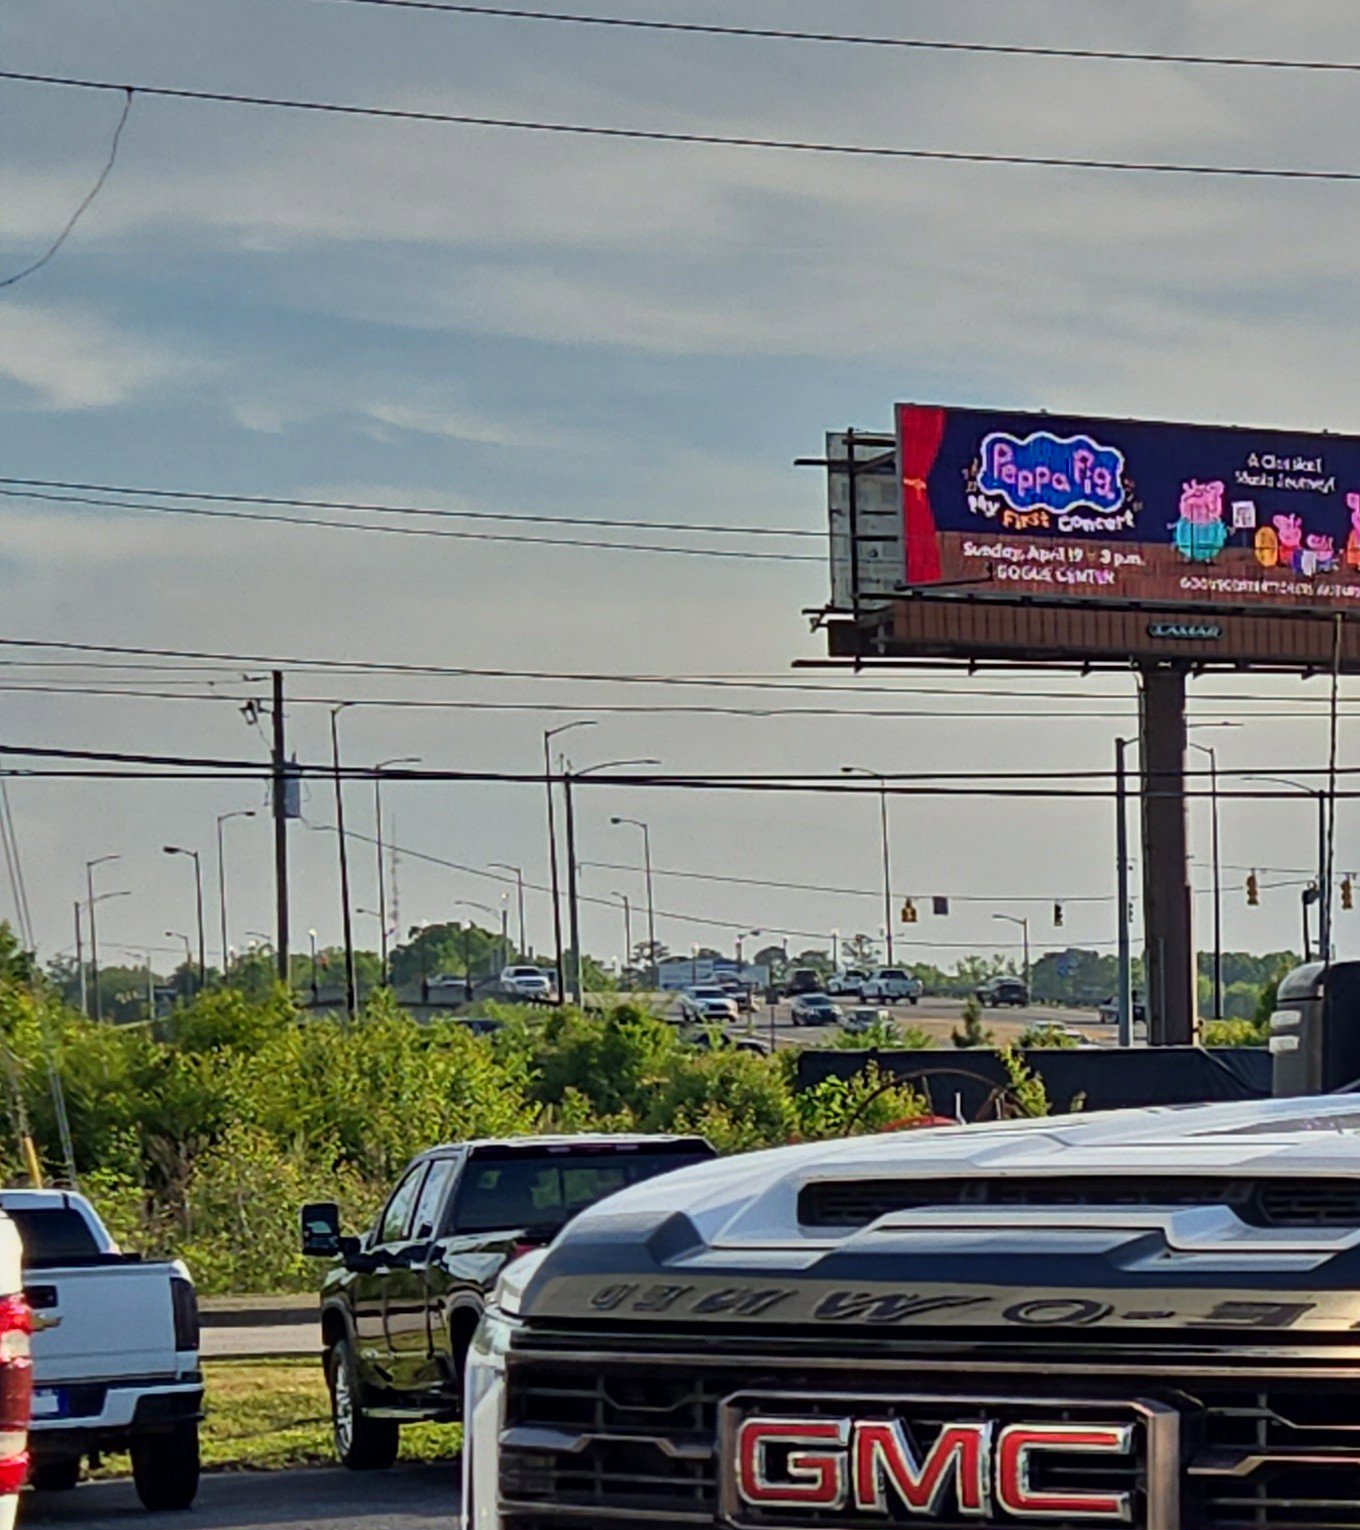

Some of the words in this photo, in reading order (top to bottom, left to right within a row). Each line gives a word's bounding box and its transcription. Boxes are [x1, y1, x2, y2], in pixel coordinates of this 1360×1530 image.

[993, 442, 1071, 497] Peppa
[1073, 449, 1116, 500] Pig
[967, 494, 1000, 518] My
[1002, 509, 1050, 530] First
[1057, 509, 1136, 532] Concert
[963, 541, 1024, 562] Sunday,
[1026, 545, 1065, 563] April
[736, 1415, 1135, 1523] GMC
